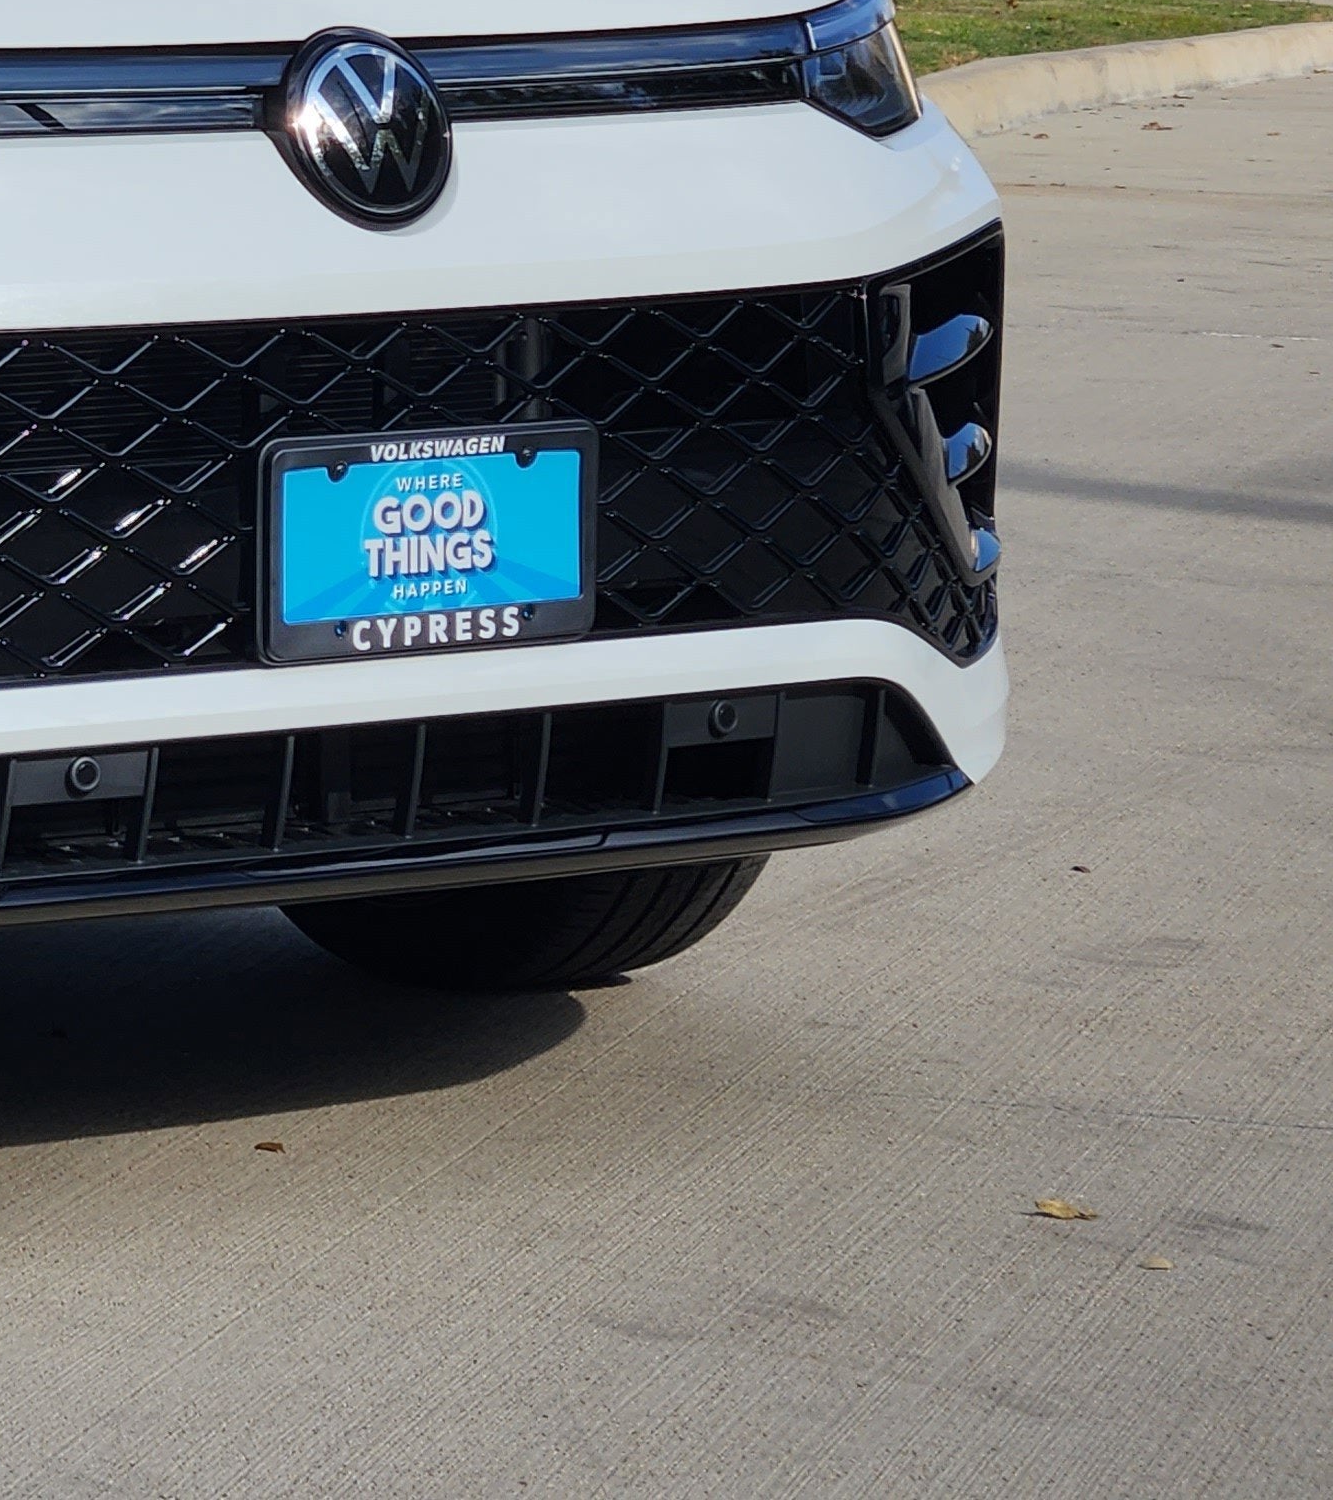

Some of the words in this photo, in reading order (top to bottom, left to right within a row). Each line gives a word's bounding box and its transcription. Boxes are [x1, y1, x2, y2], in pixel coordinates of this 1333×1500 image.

[370, 435, 505, 462] VOLKSWAGEN
[397, 473, 463, 492] WHERE
[375, 491, 484, 534] GOOD
[365, 530, 494, 577] THINGS
[393, 580, 467, 598] HAPPEN
[351, 606, 520, 651] CYPRESS
